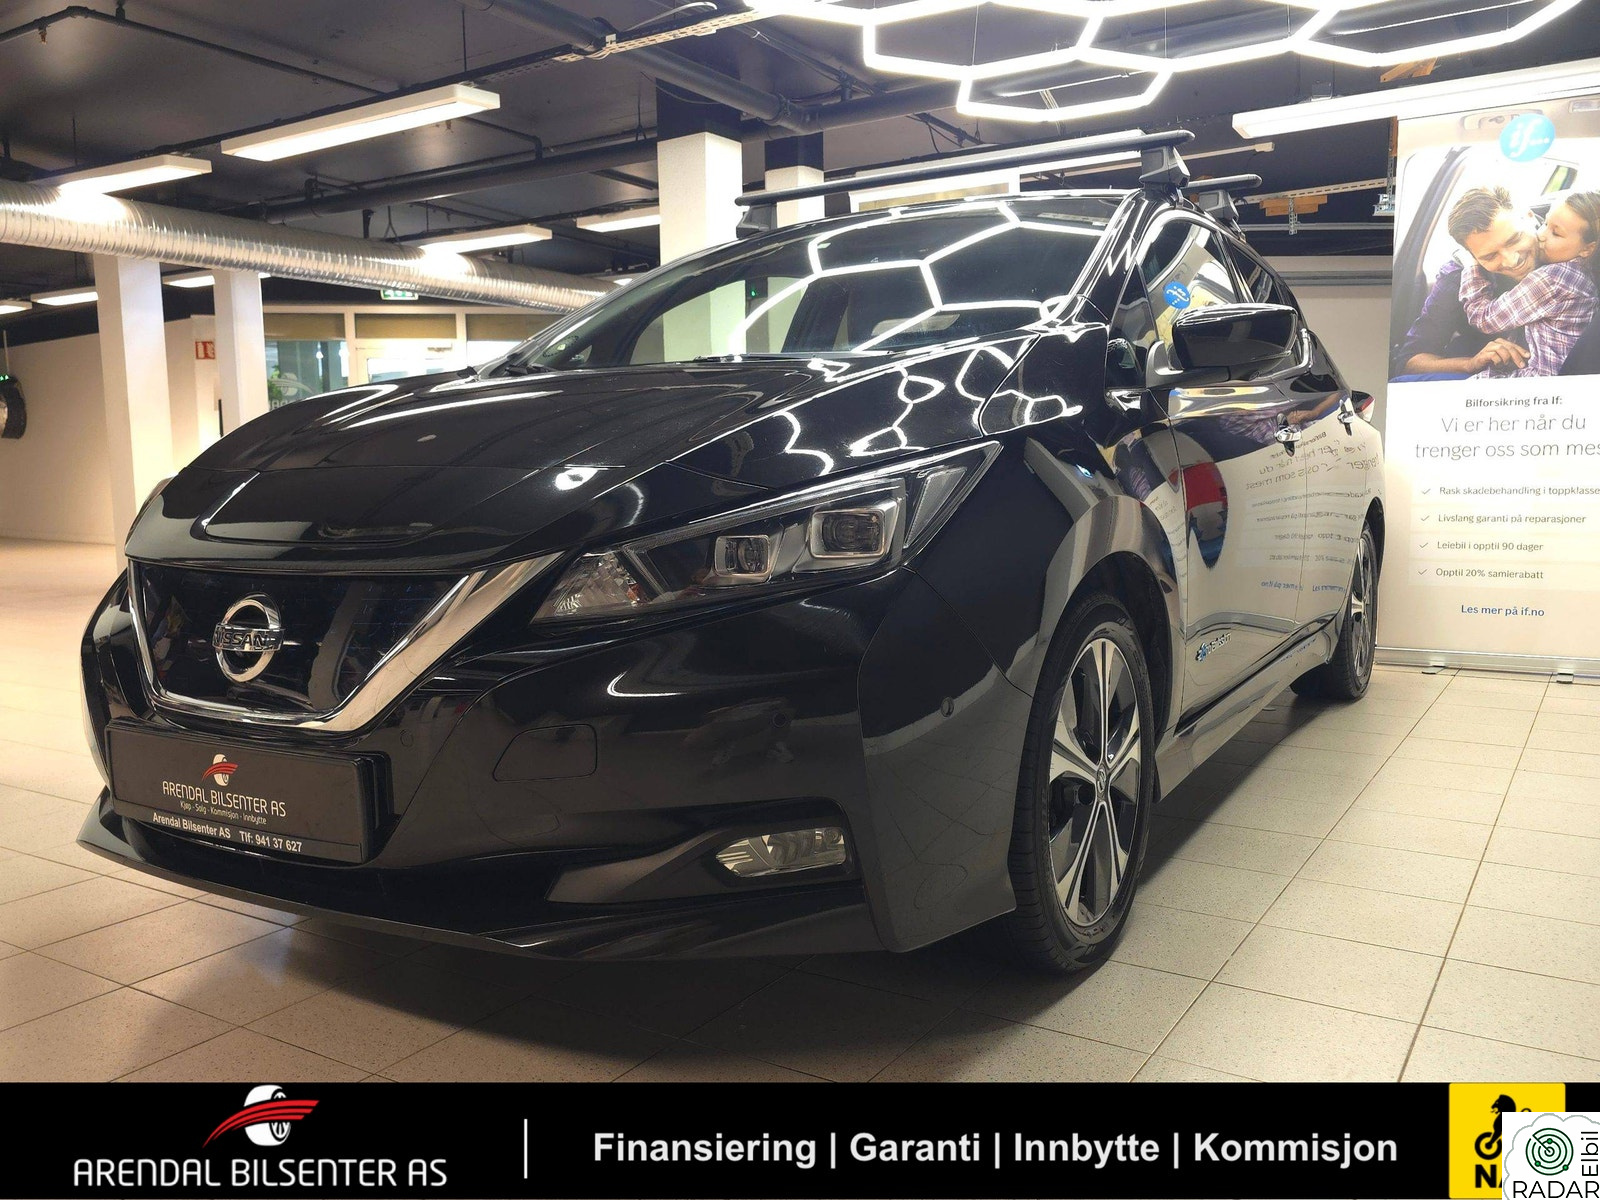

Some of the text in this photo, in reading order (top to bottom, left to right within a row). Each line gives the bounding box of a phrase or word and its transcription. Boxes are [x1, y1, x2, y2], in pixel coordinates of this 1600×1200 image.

[1465, 397, 1530, 408] Bilforsikring
[1533, 396, 1549, 405] fra
[1441, 414, 1586, 433] Vi er her når du
[1415, 443, 1480, 461] trenger
[1486, 445, 1514, 458] oss
[1520, 443, 1559, 457] som
[1439, 487, 1461, 495] Rask
[1462, 486, 1541, 497] skadebehandling
[1548, 486, 1600, 497] toppklasse
[1438, 514, 1586, 525] Livslang garanti på reparasjoner
[1437, 541, 1466, 550] Leiebil
[1473, 542, 1500, 551] opptil
[1502, 542, 1514, 550] 90
[1516, 543, 1544, 552] dager
[1436, 568, 1464, 578] Opptil
[1465, 569, 1486, 577] 20%
[1461, 604, 1545, 617] Les mer på if.no
[162, 780, 287, 817] ARENDAL BILSENTER AS
[152, 812, 302, 852] Arendal Bilsenter AS Tlf: 941 37 627
